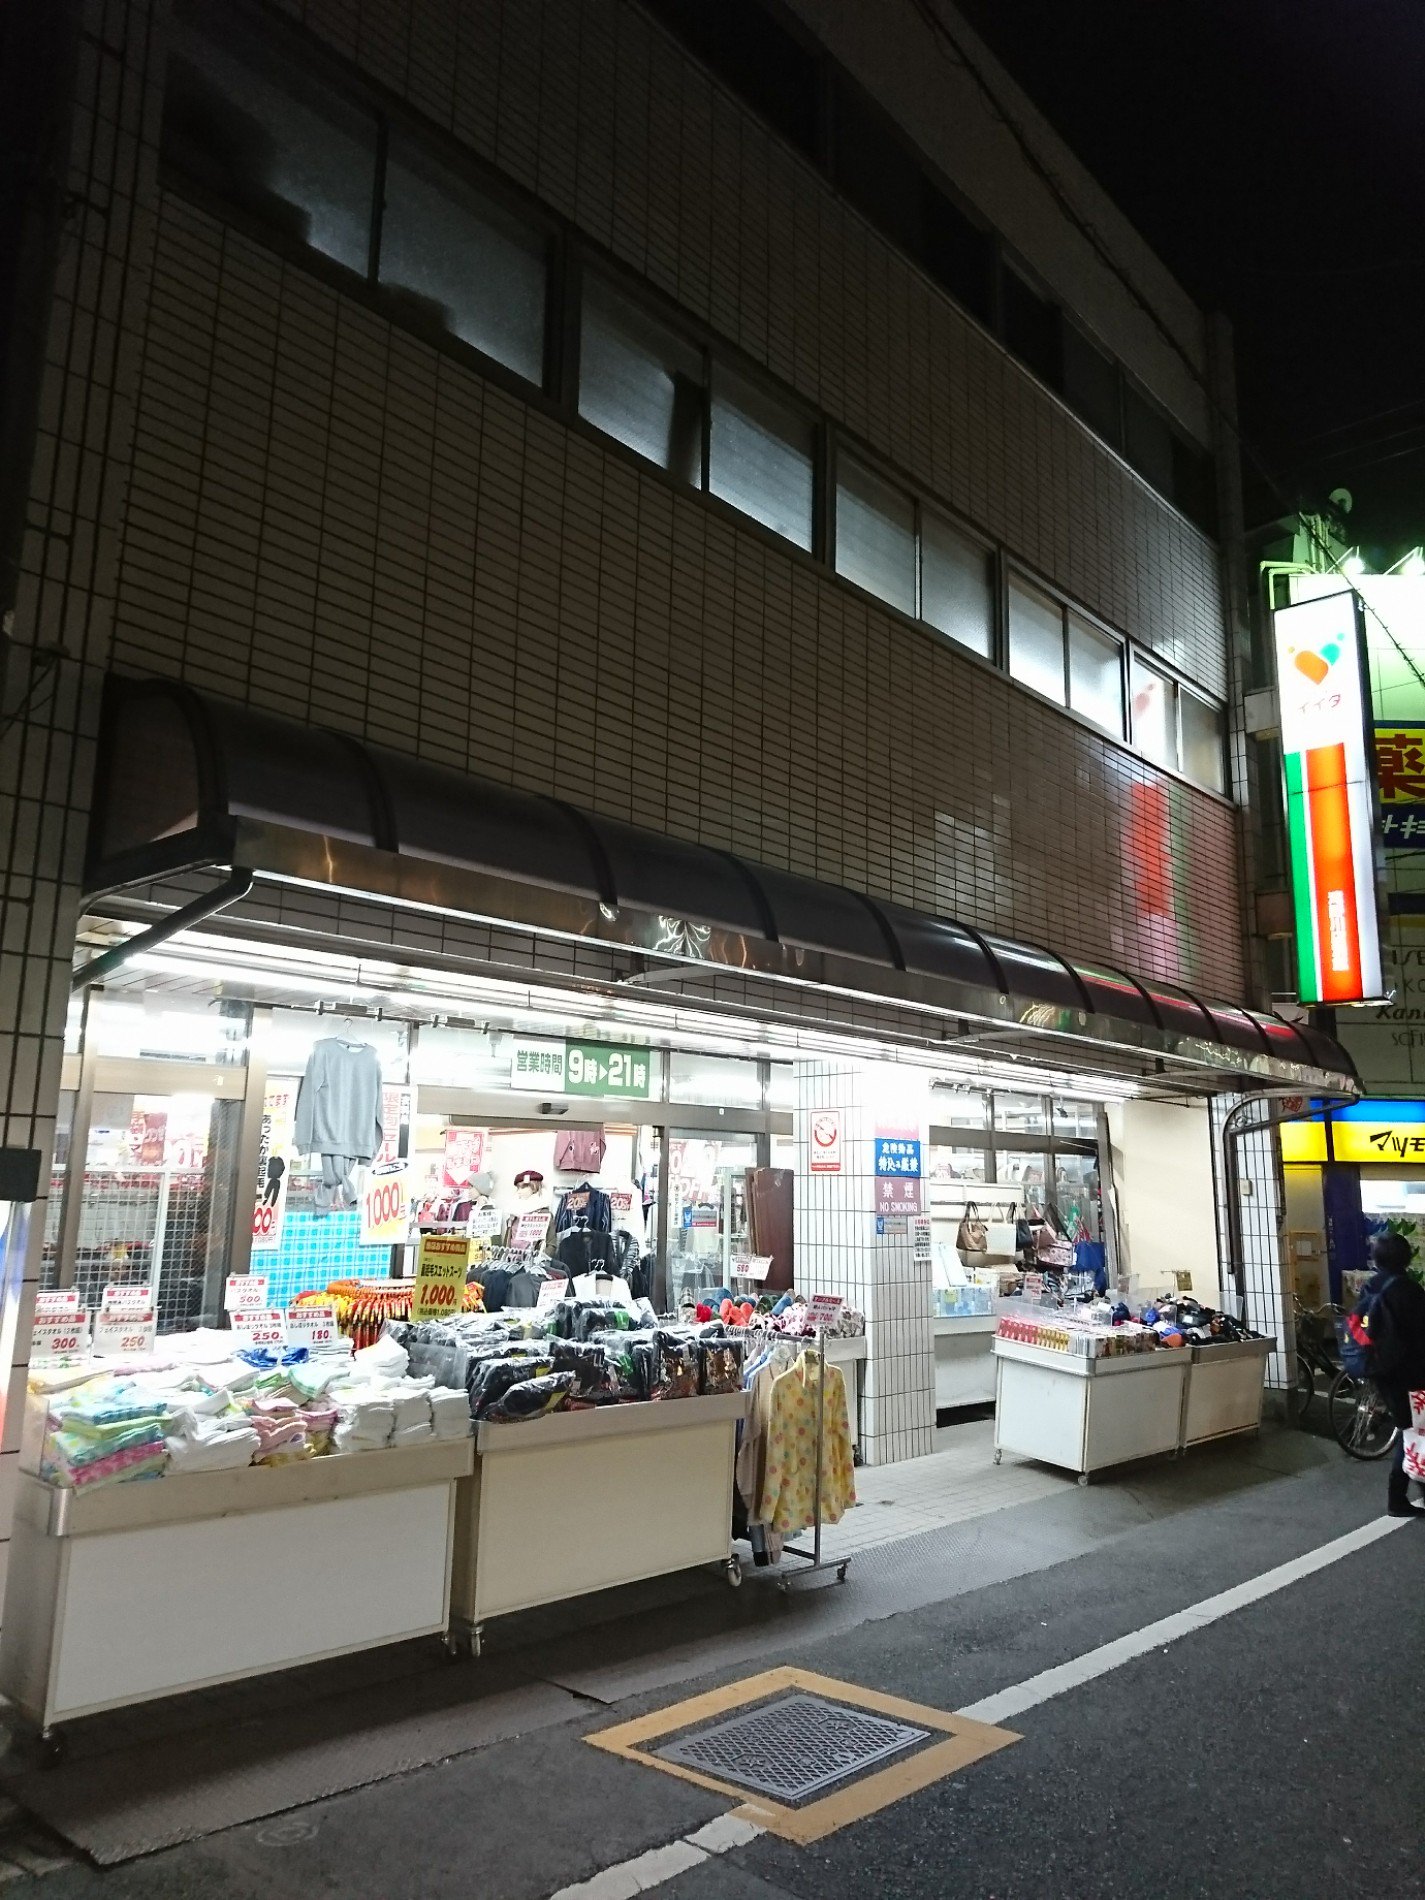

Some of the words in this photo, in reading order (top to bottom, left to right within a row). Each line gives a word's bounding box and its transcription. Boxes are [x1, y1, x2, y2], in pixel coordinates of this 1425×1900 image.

[516, 1049, 563, 1076] 営業時間
[879, 1201, 889, 1212] NO
[890, 1201, 918, 1213] SMOKING
